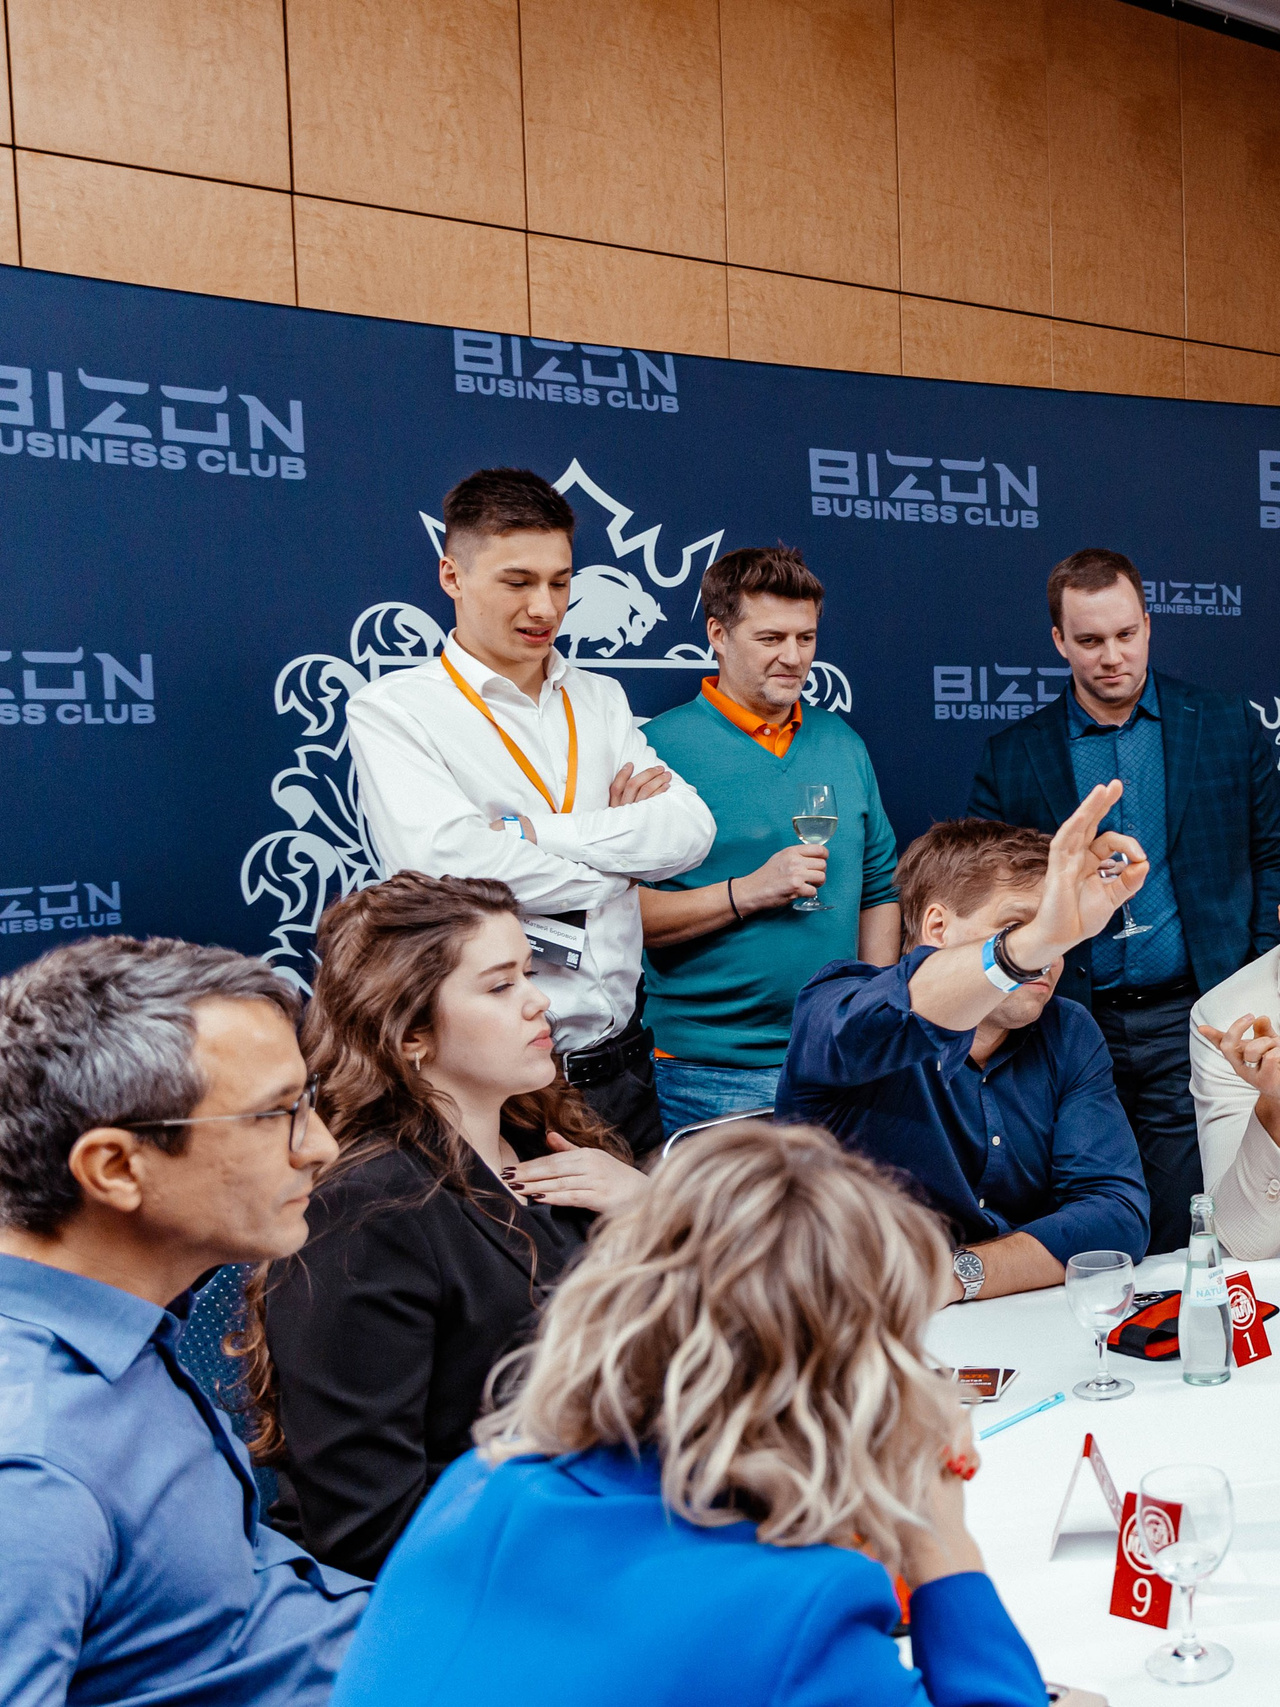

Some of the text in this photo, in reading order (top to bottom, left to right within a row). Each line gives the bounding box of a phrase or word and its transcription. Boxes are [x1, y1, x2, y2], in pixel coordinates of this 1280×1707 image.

[453, 329, 678, 393] BIZON
[455, 374, 679, 413] BUSINESS CLUB
[0, 429, 307, 480] USINESS CLUB
[809, 448, 1038, 507] BIZON
[811, 496, 1039, 528] BUSINESS CLUB
[1145, 604, 1241, 616] USINESS CLUB
[933, 662, 1072, 702] BIZO
[56, 703, 156, 724] CLUB
[61, 912, 122, 930] CLUB
[1243, 1332, 1258, 1359] 1
[1131, 1578, 1152, 1617] 9
